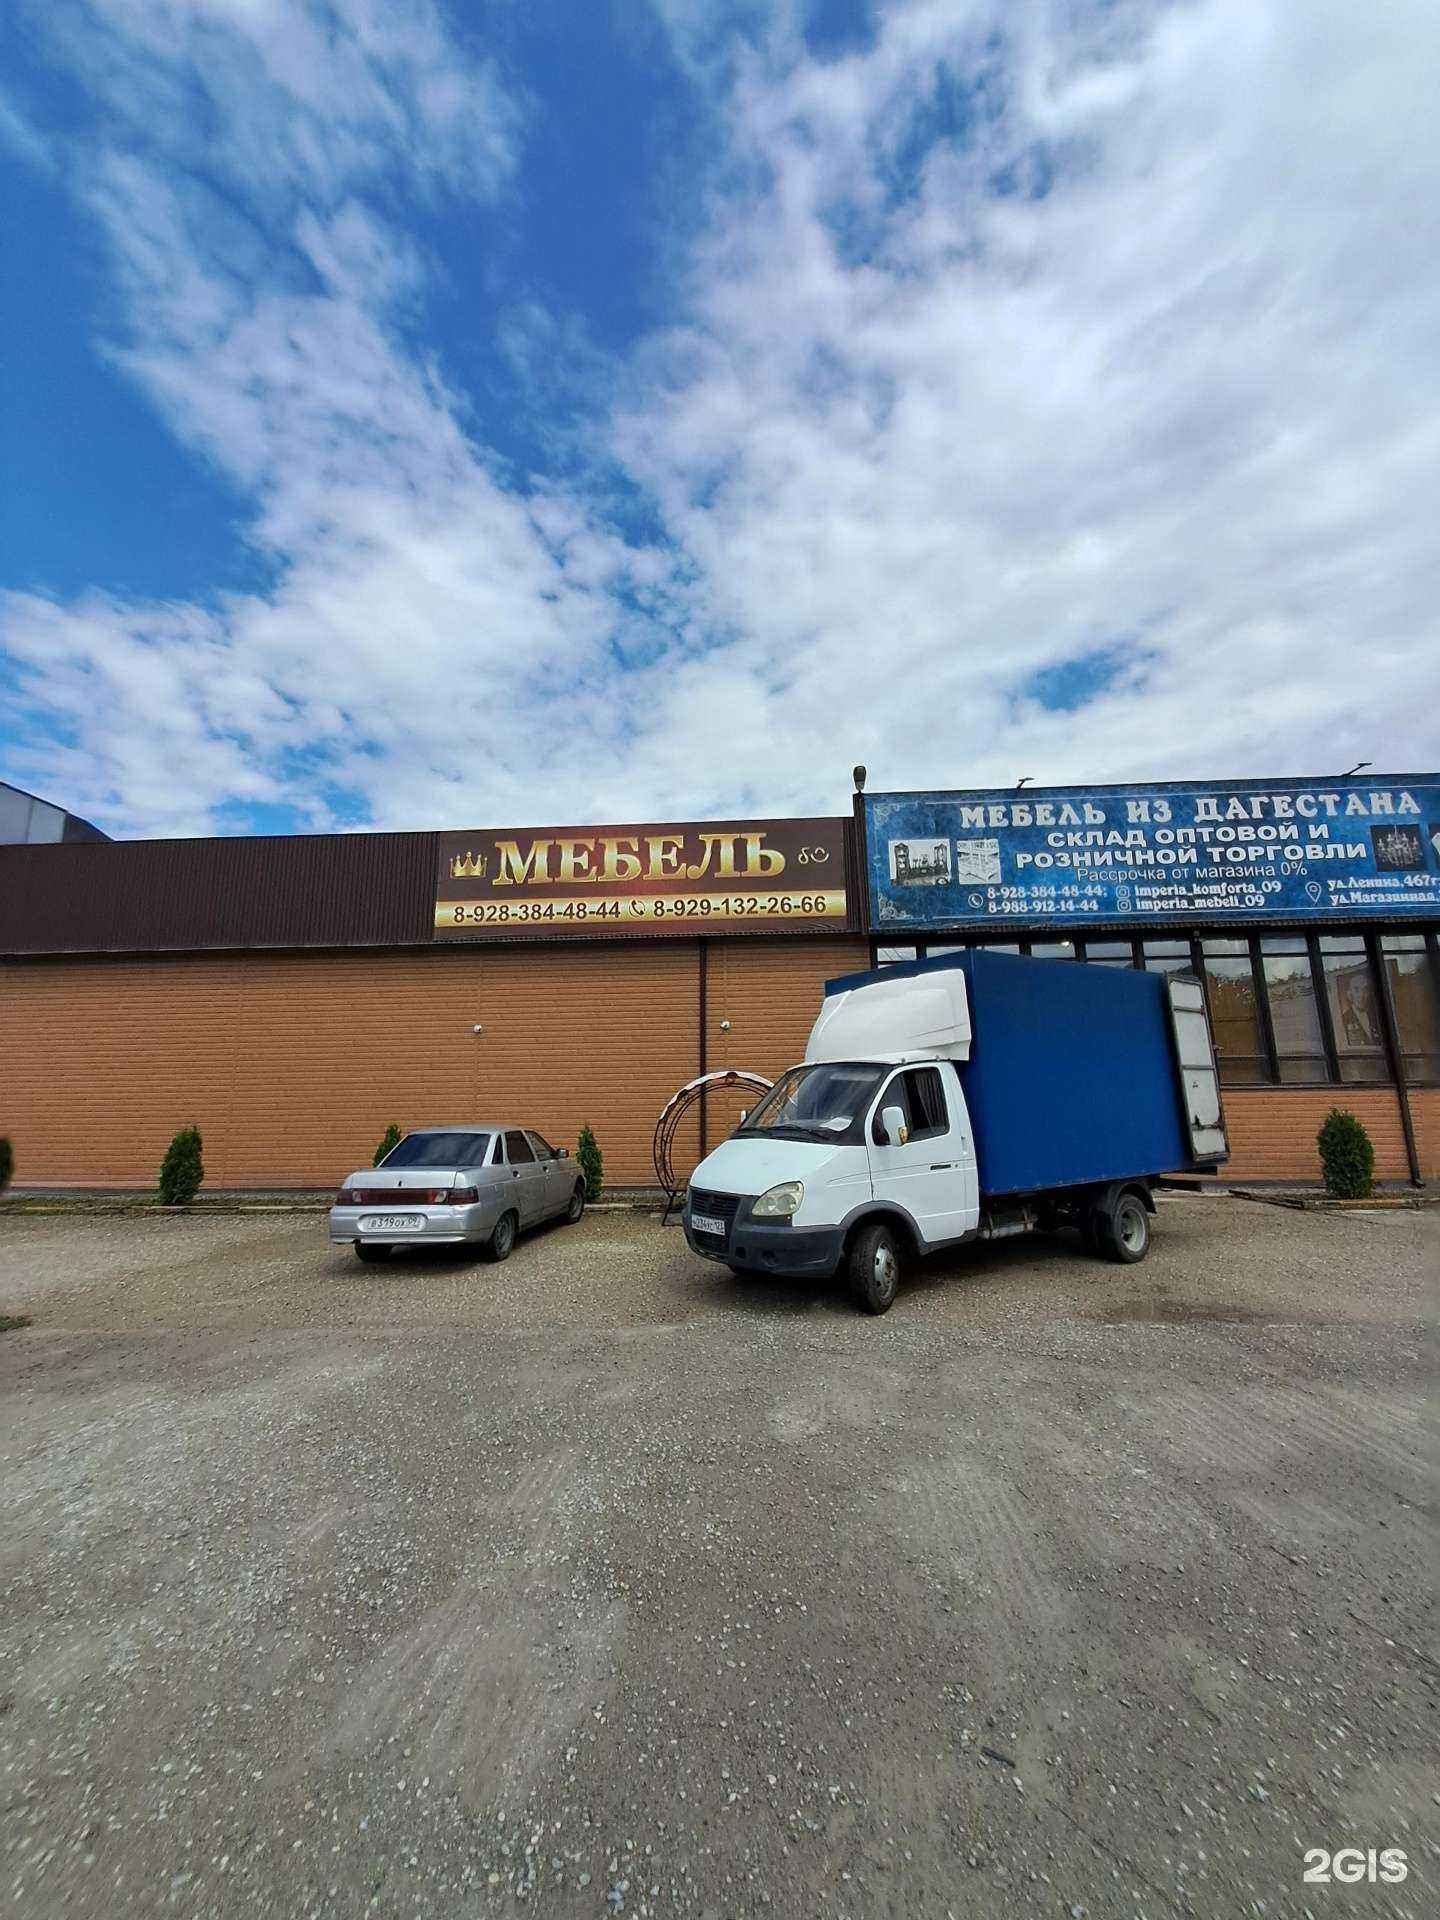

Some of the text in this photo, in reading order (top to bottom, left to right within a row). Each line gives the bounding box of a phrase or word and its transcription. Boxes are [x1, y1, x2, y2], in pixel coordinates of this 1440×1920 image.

[961, 791, 1422, 828] МЕБЕЛЬ ИЗ ДАГЕСТАНА
[1047, 821, 1329, 848] СКЛАД ОПТОВОЙ И
[492, 832, 786, 885] МЕБЕЛЬ
[1016, 843, 1367, 868] РОЗНИЧНОЙ ТОРГОВЛИ
[1077, 861, 1308, 883] Рассрочка от магазина 0%
[453, 895, 827, 923] 8-928-384-48-44 8-929-132-26-66
